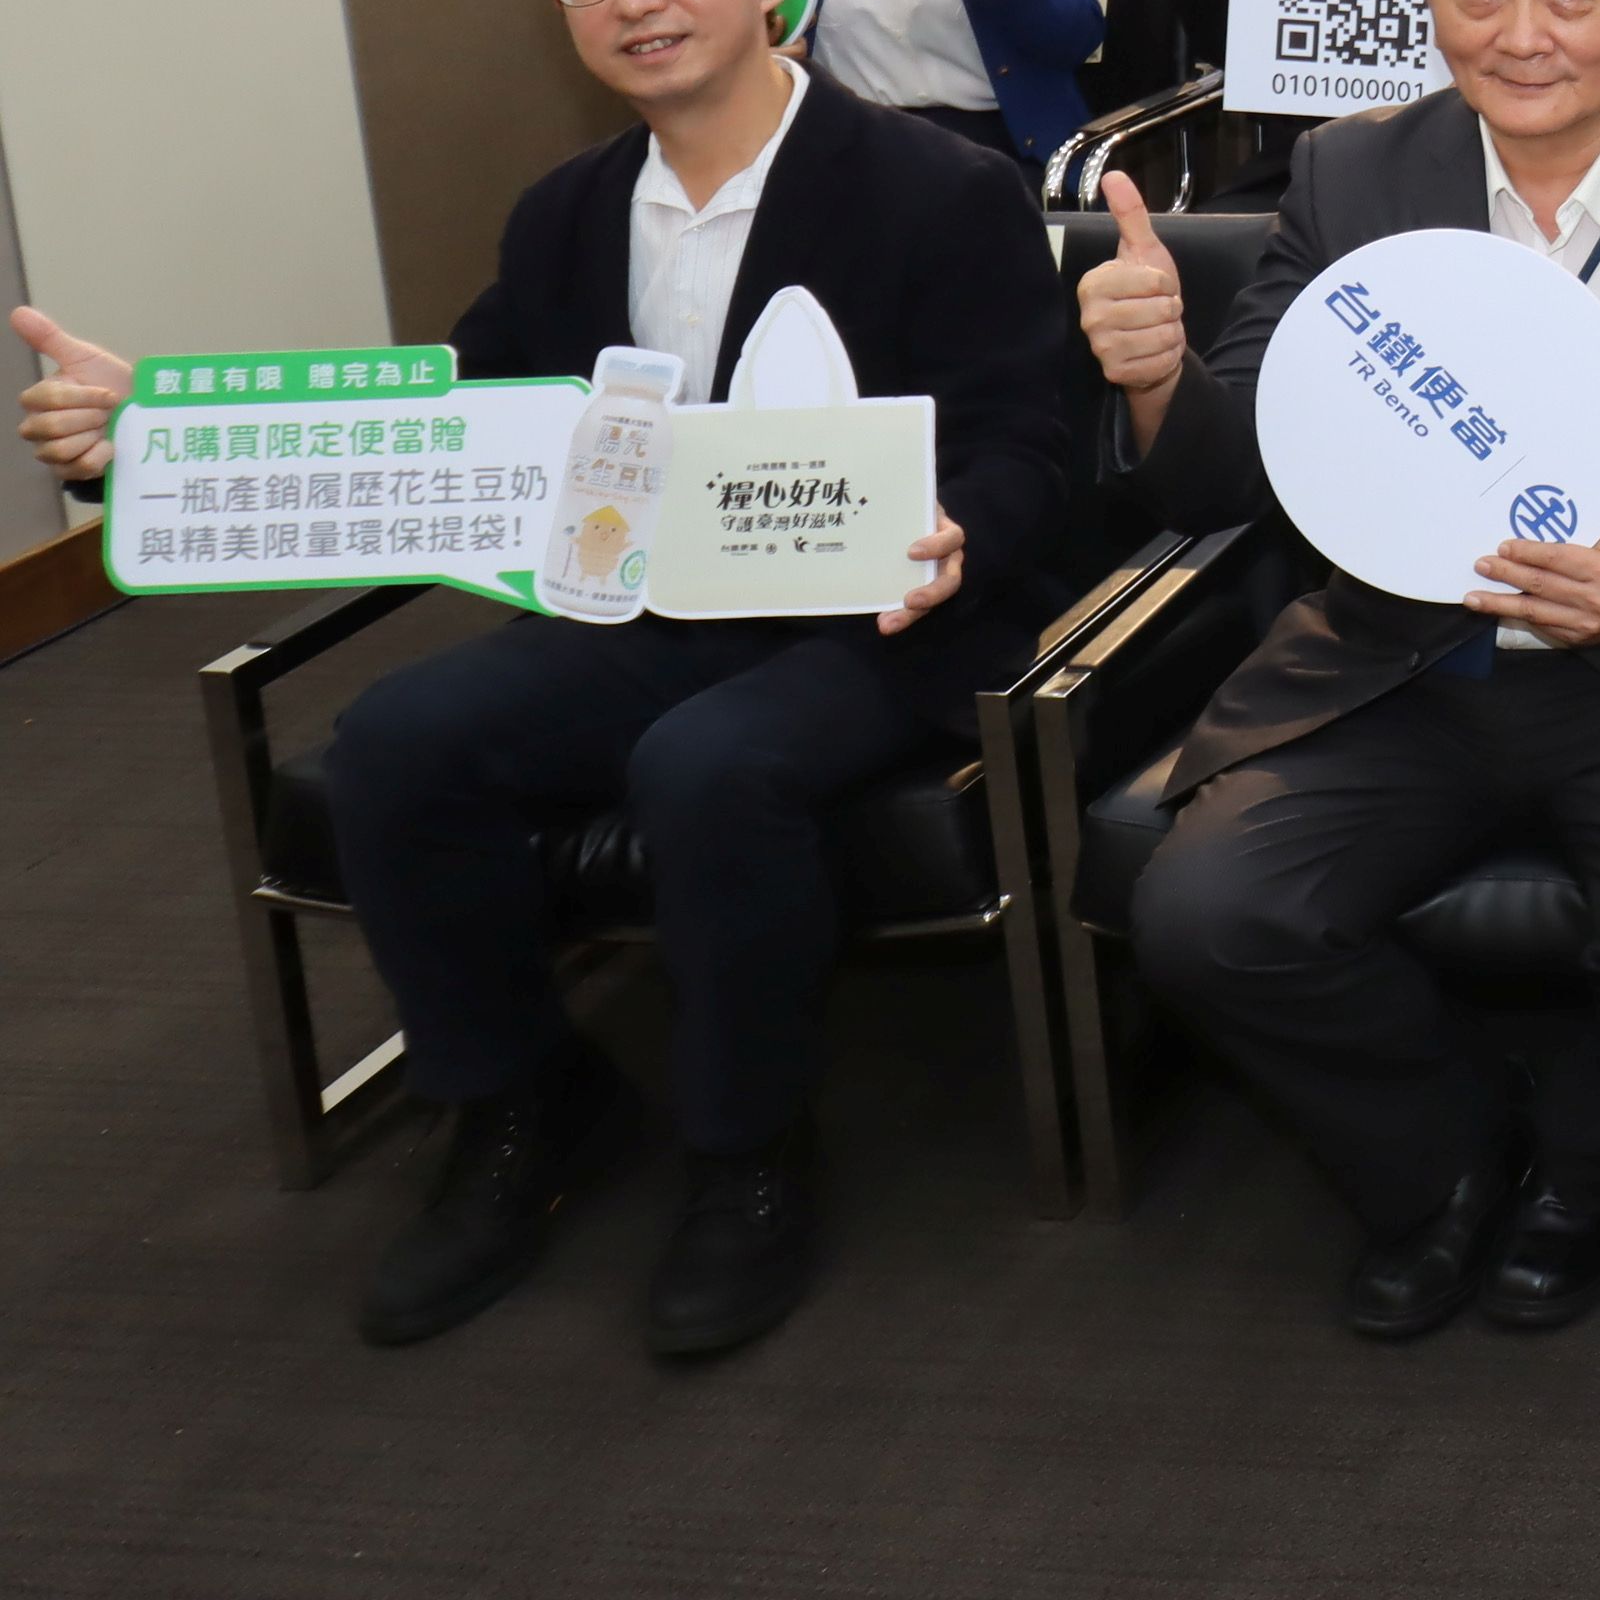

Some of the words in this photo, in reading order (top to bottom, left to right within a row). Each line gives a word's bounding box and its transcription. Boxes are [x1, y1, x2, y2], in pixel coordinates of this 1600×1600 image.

[1272, 73, 1425, 102] 0101000001
[154, 364, 284, 396] 數量有限
[307, 361, 436, 390] 贈完為止
[1324, 281, 1508, 462] 台鐵便當
[1348, 350, 1377, 382] TR
[1373, 378, 1430, 438] Bento
[140, 416, 468, 464] 凡購買限定便當贈
[140, 465, 548, 515] 一瓶產銷履歷花生豆奶
[717, 477, 851, 511] 糧心好味
[720, 511, 846, 533] 守護臺灣好滋味
